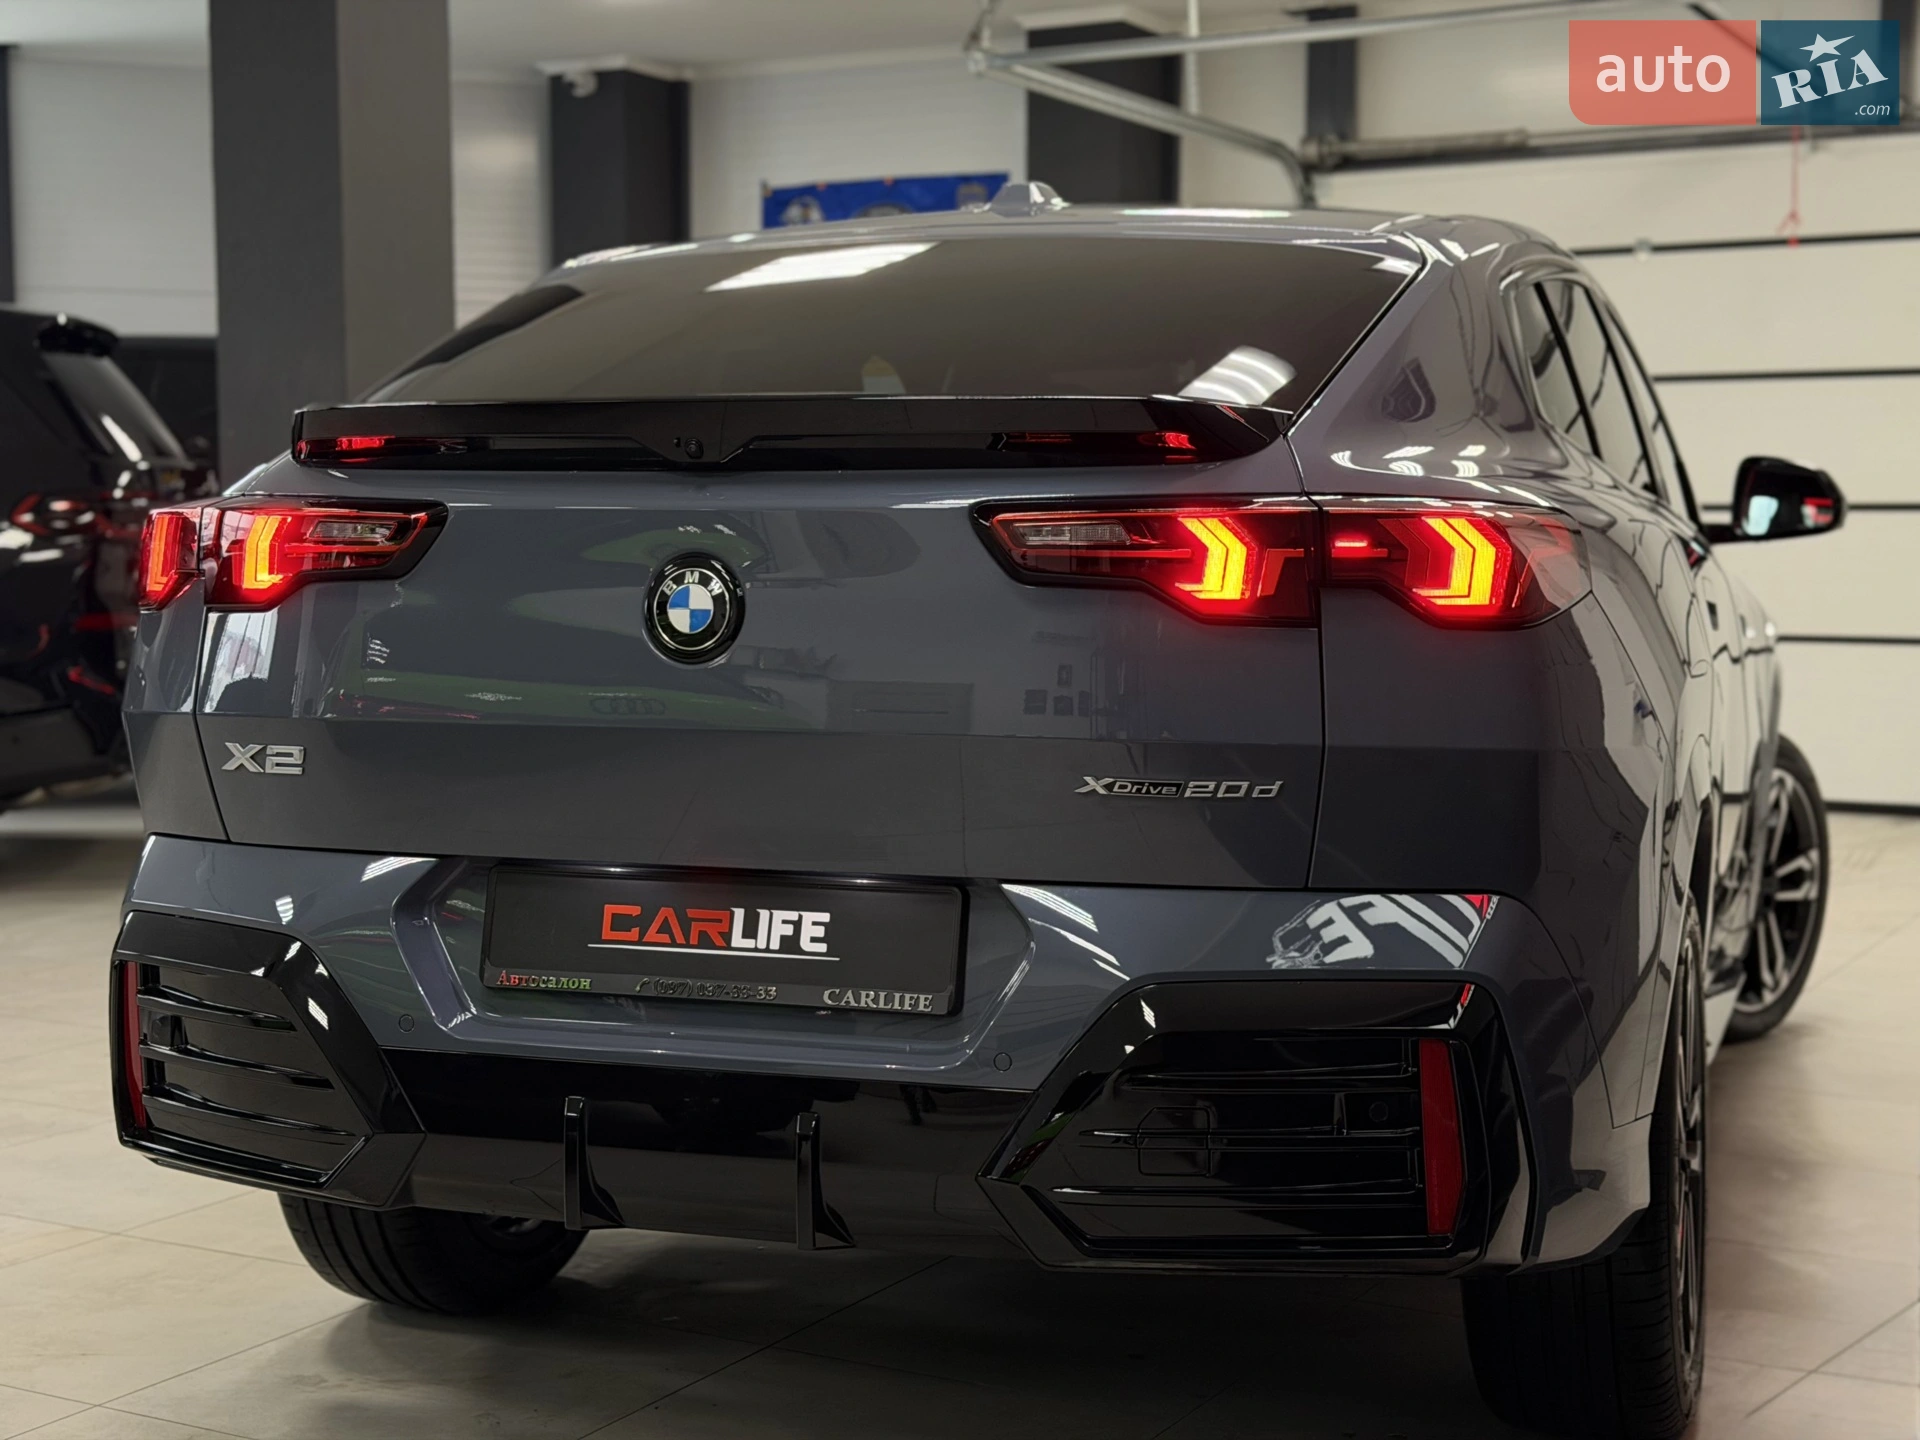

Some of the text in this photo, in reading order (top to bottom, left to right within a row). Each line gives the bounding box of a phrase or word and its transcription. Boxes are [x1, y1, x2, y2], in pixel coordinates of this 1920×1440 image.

[662, 570, 723, 596] BMW
[221, 742, 304, 775] X2
[602, 904, 831, 953] CARLIFE
[496, 970, 592, 990] Автосалон
[823, 988, 933, 1012] CARLIFE
